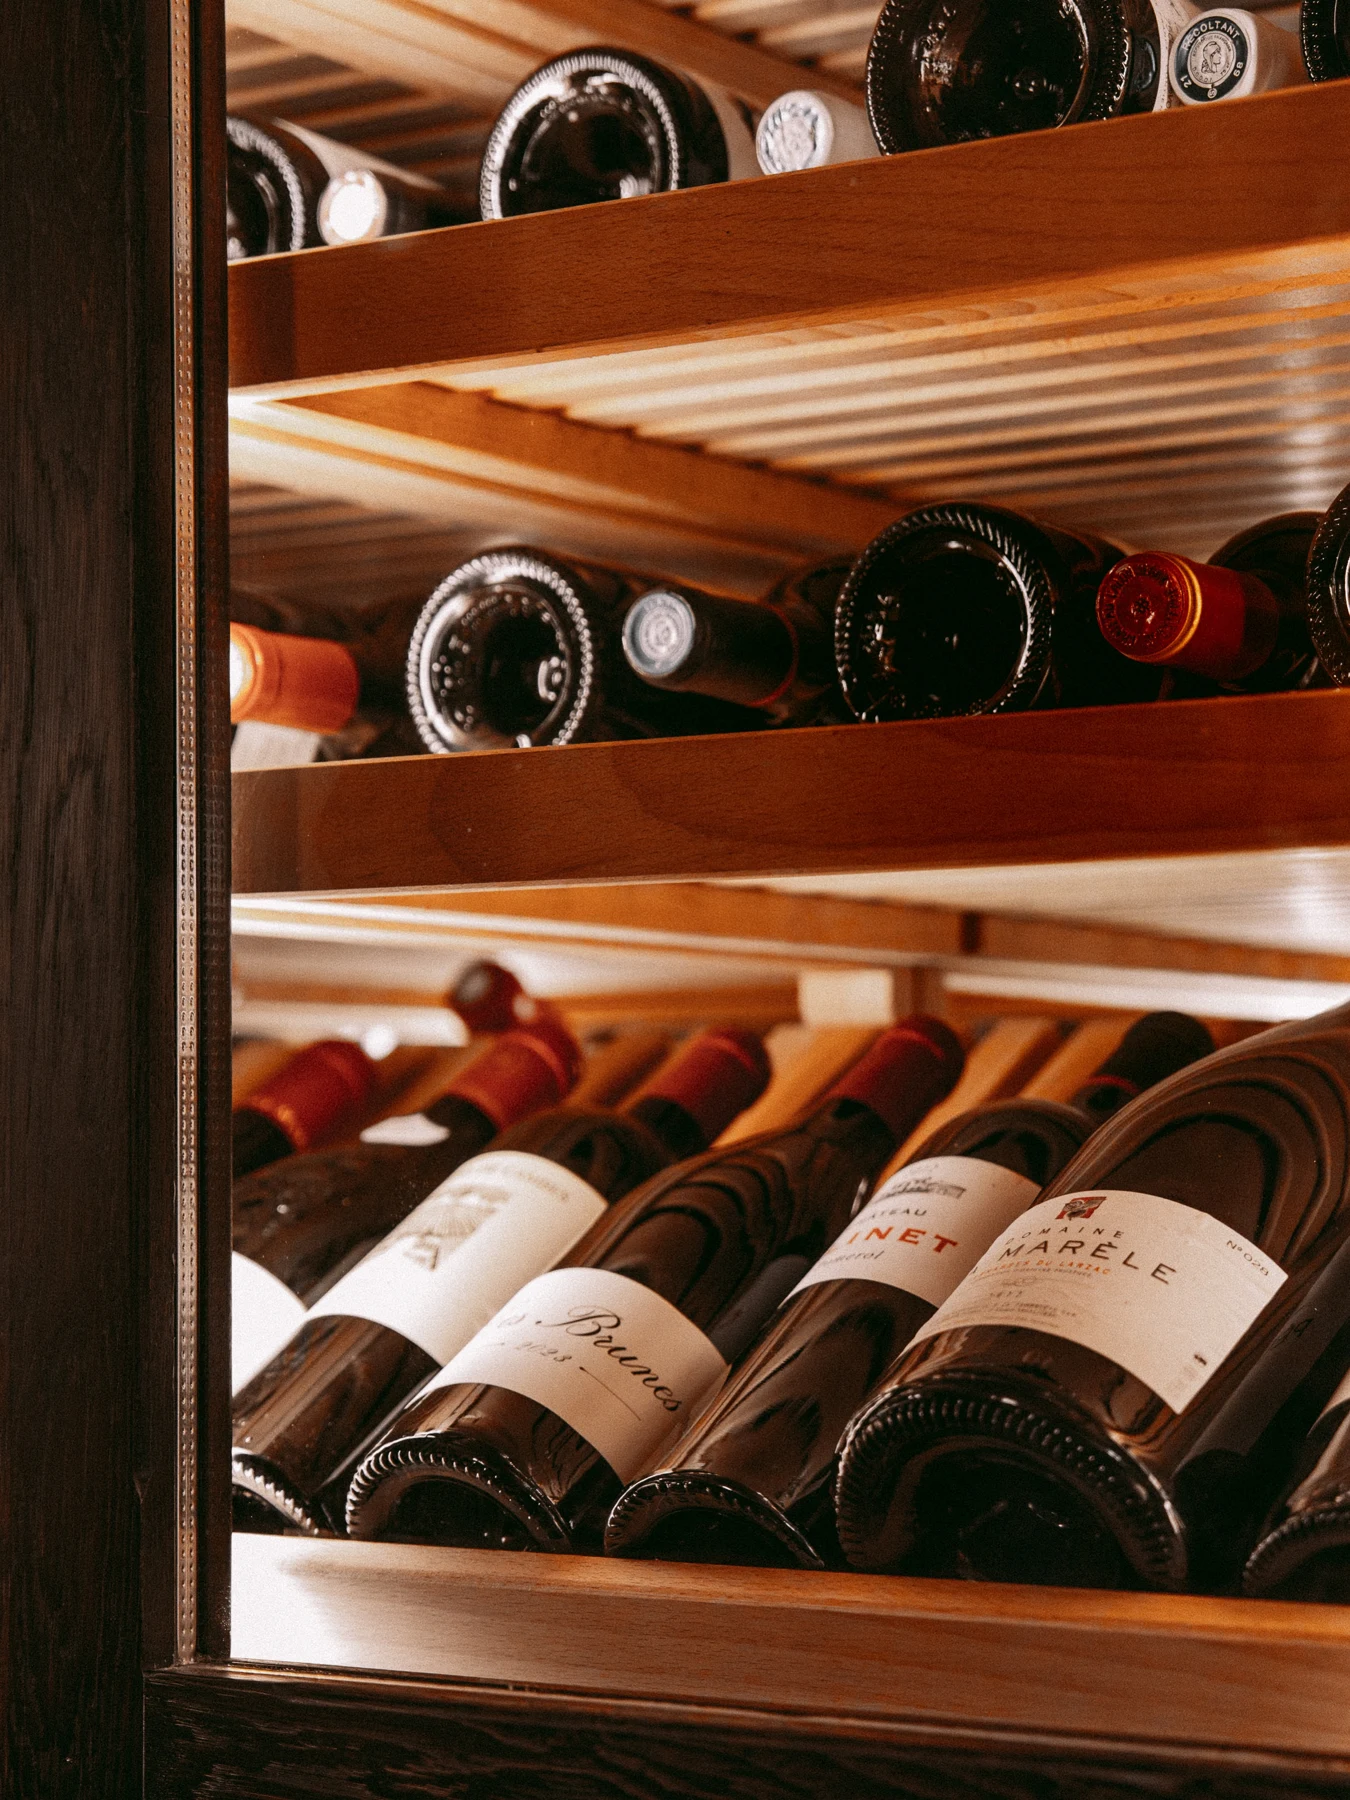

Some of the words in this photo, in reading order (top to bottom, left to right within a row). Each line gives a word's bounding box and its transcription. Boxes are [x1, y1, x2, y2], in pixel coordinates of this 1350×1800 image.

[1005, 1226, 1125, 1246] DOMAINE
[998, 1240, 1177, 1285] MARÈLE
[534, 1304, 683, 1412] Brunes
